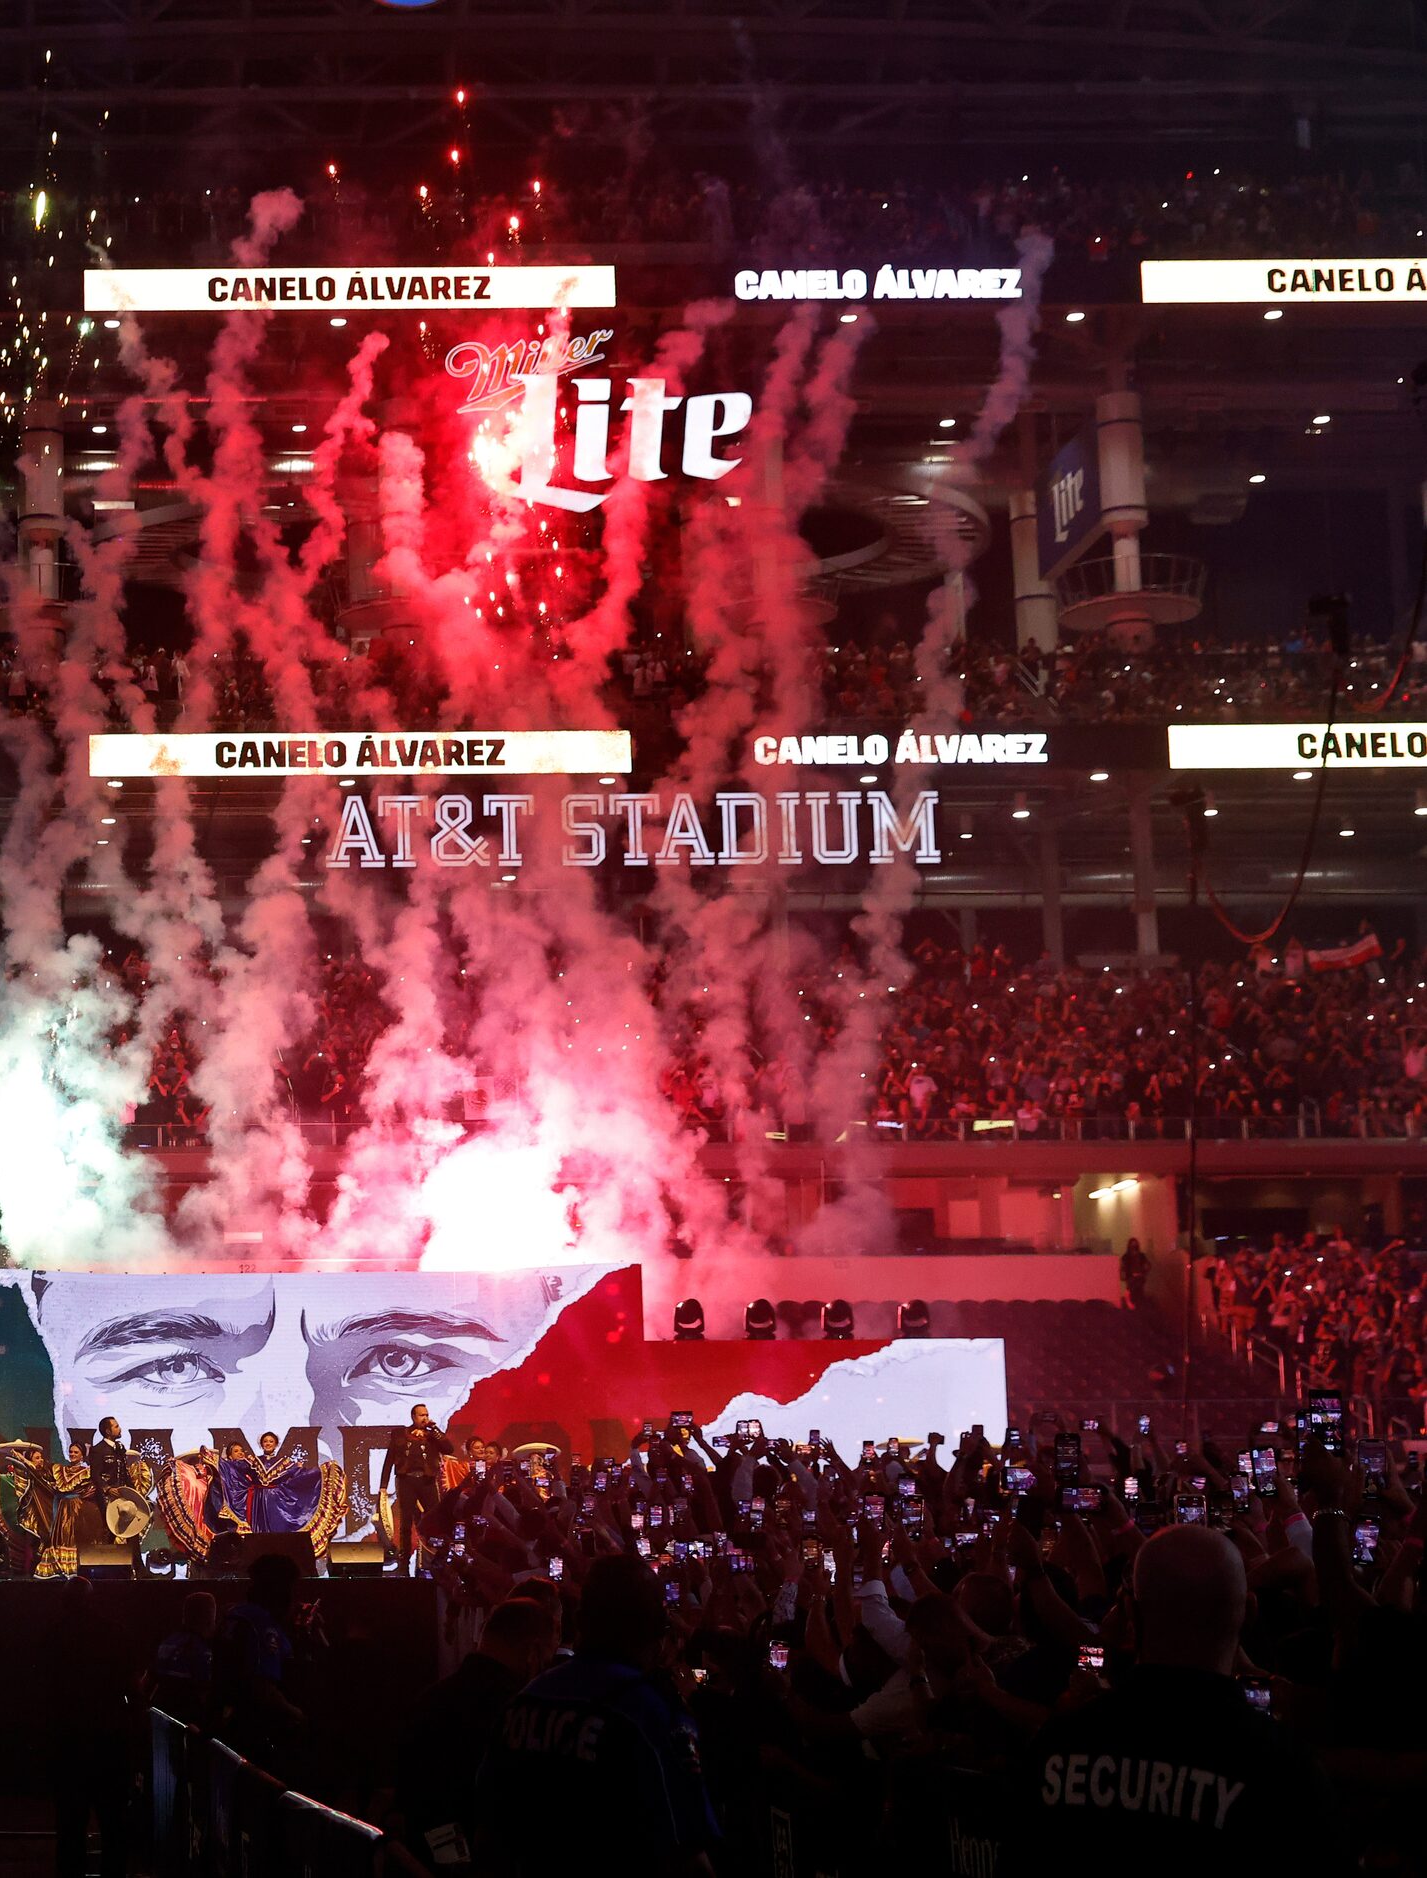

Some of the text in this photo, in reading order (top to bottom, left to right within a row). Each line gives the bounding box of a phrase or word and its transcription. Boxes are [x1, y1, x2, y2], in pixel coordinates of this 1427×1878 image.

[208, 271, 491, 302] CANELO ÁLVAREZ
[734, 264, 1023, 300] CANELO ÁLVAREZ
[1267, 268, 1394, 293] CANELO
[509, 373, 753, 514] Lite
[1051, 468, 1084, 543] Lite
[215, 735, 506, 769] CANELO ÁLVAREZ
[754, 729, 1048, 766] CANELO ÁLVAREZ
[1297, 732, 1427, 760] CANELO
[326, 790, 940, 868] AT&T STADIUM
[1041, 1752, 1247, 1831] SECURITY
